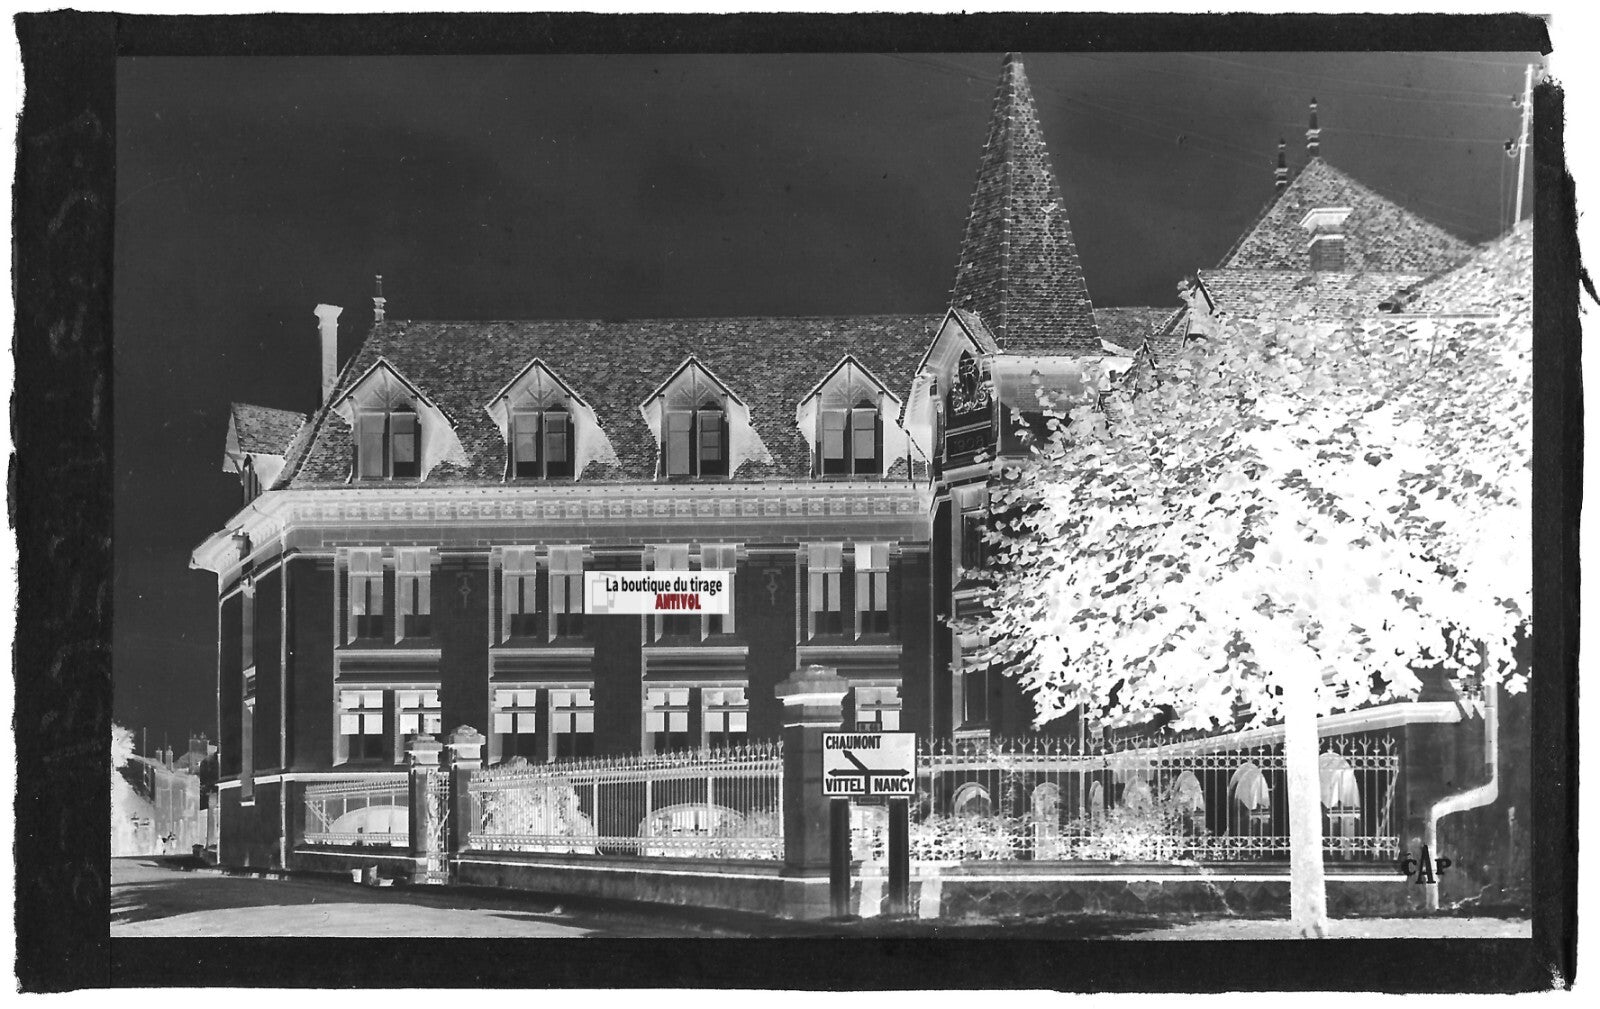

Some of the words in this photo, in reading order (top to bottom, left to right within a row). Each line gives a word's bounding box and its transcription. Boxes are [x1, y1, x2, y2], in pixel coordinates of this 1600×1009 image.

[825, 735, 882, 750] CHAUMONT
[825, 778, 865, 792] VITTEL
[874, 778, 914, 792] NANCY
